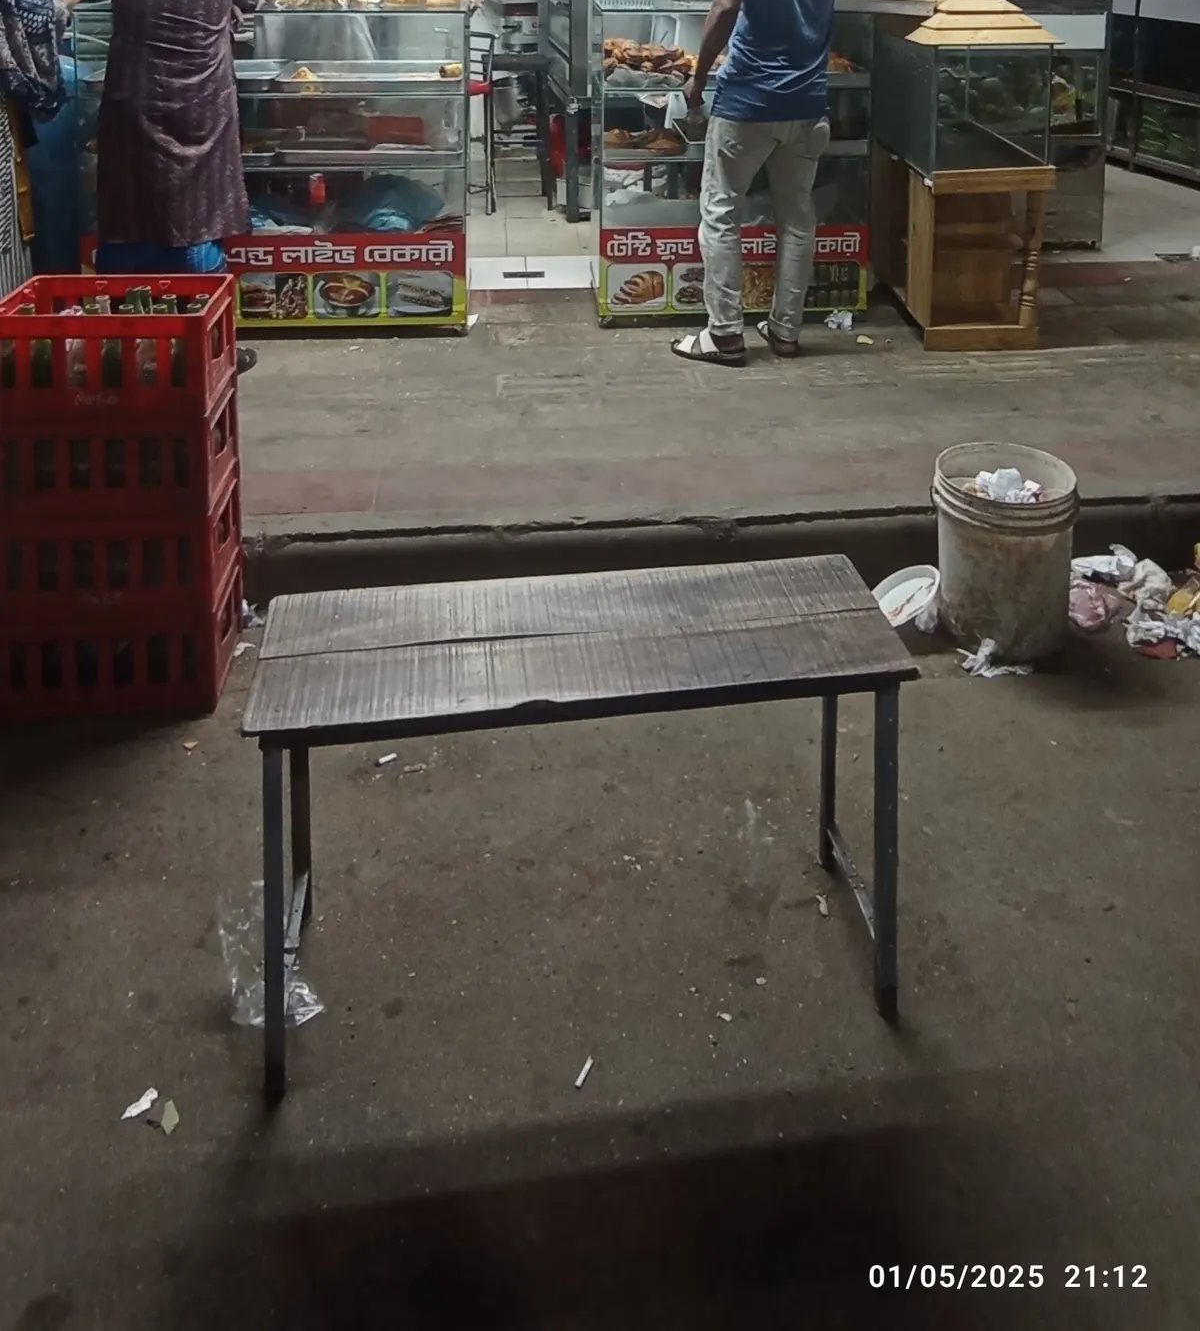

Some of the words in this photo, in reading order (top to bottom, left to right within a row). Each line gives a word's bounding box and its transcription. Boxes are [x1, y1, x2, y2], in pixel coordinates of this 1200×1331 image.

[226, 244, 275, 266] এন্ড
[280, 240, 357, 264] লাইভ
[363, 240, 455, 267] বেকারী
[606, 231, 652, 257] টেস্টি
[655, 238, 695, 260] ফুড
[740, 232, 778, 255] লাই
